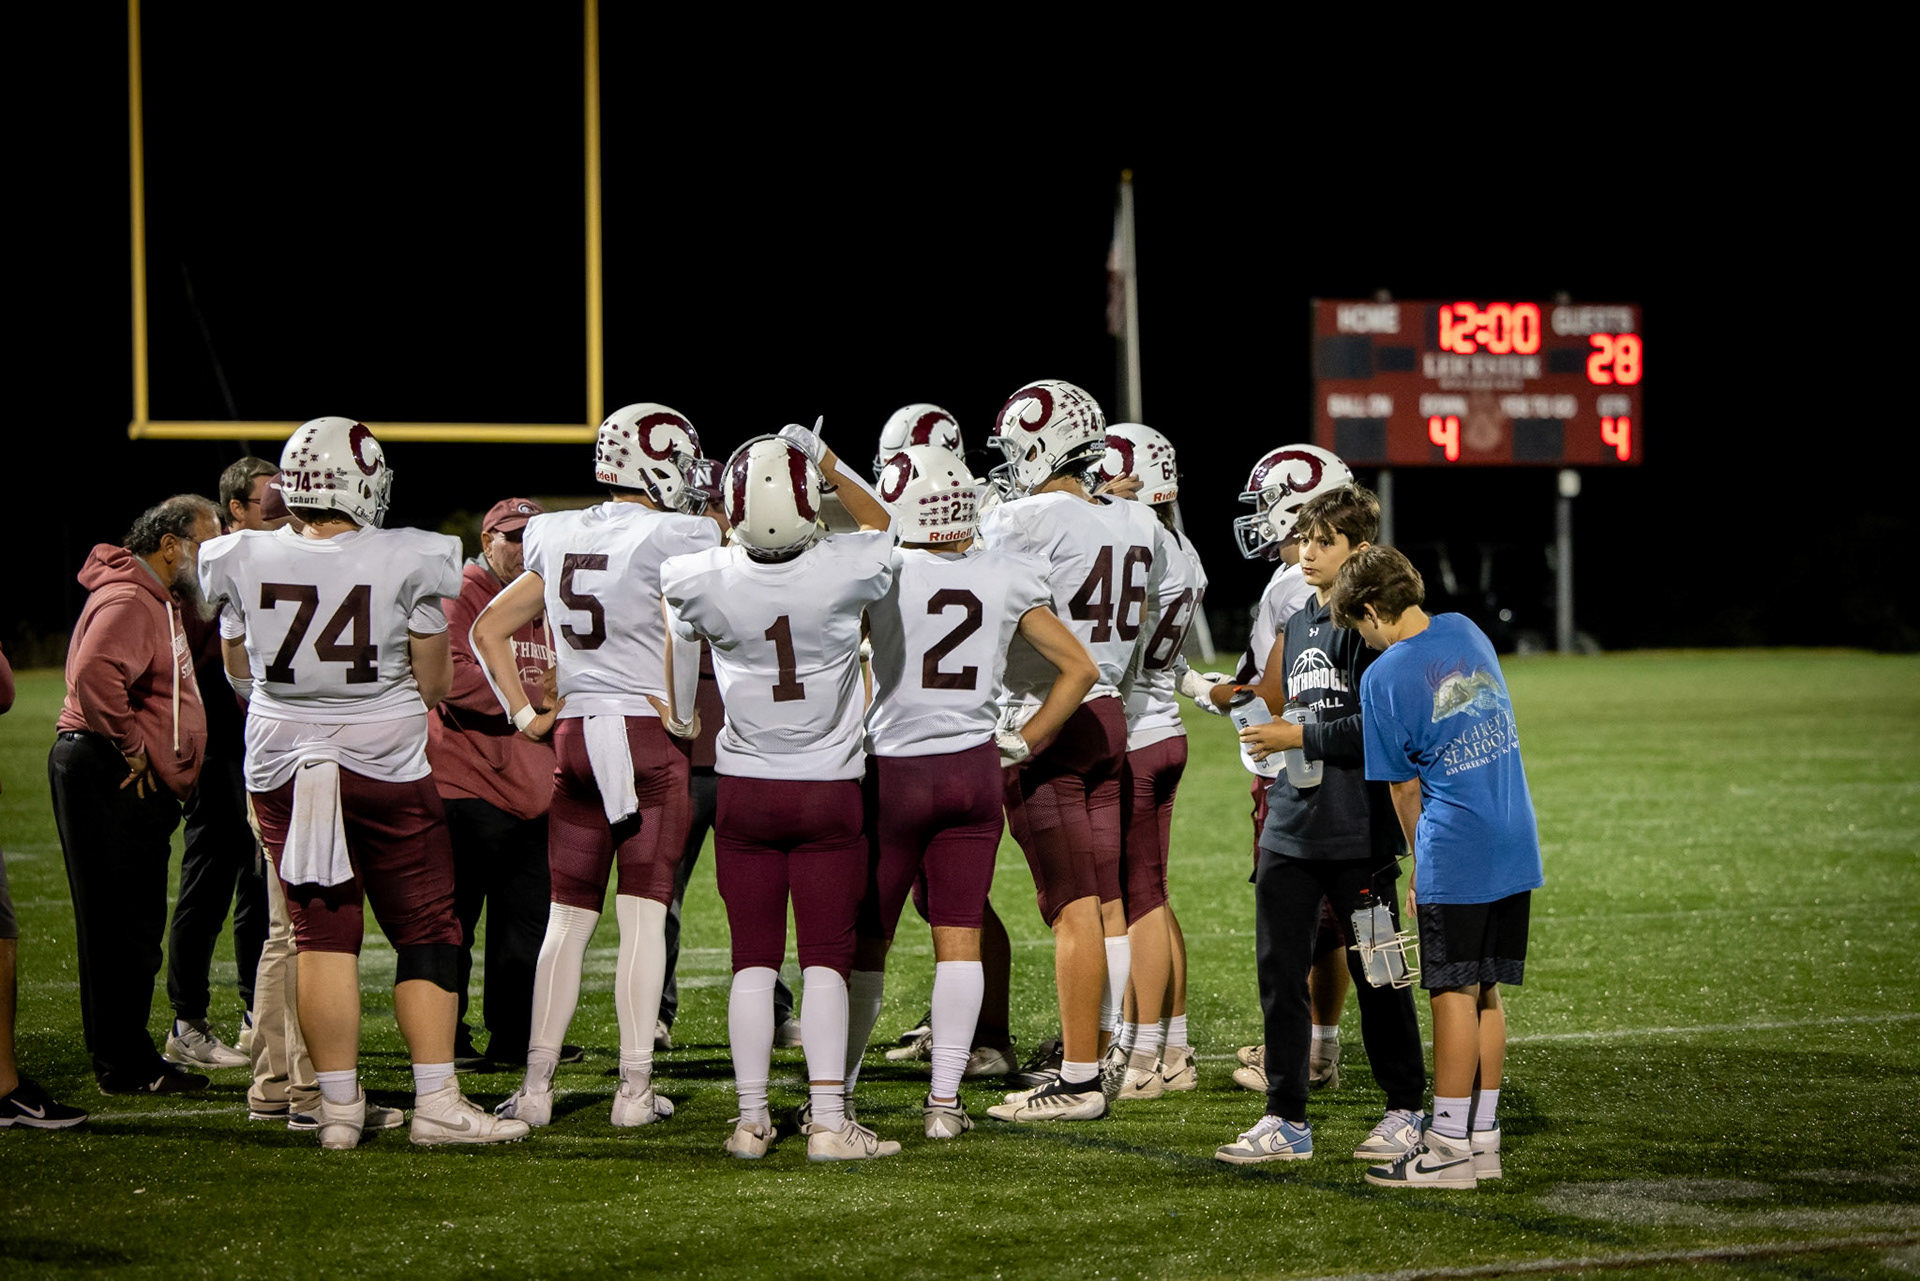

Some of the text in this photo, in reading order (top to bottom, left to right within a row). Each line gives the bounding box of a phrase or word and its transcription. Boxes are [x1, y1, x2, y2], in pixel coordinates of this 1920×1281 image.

[1439, 302, 1542, 355] 12:00
[1586, 333, 1643, 385] 28
[1428, 415, 1460, 462] 4
[1600, 415, 1632, 462] 4
[292, 471, 312, 492] 74
[929, 527, 973, 542] Riddell
[951, 500, 962, 522] 2
[559, 553, 608, 650] 5
[1068, 545, 1153, 643] 46
[260, 582, 378, 685] 74
[765, 615, 806, 702] 1
[922, 588, 983, 690] 2
